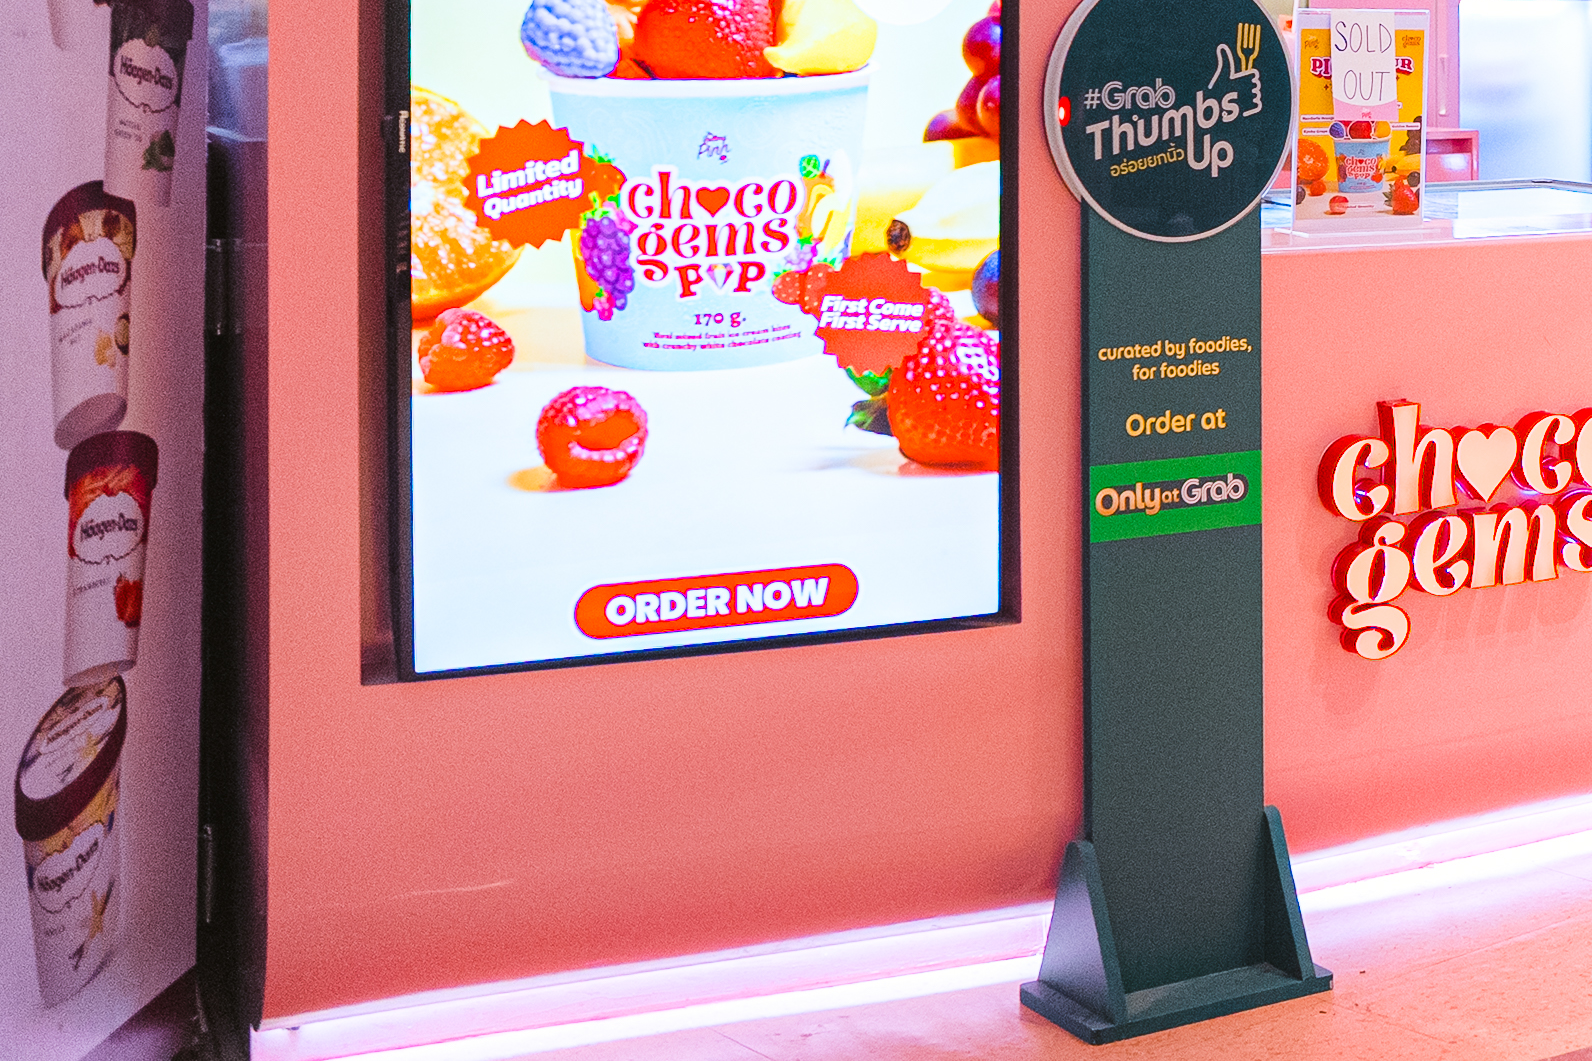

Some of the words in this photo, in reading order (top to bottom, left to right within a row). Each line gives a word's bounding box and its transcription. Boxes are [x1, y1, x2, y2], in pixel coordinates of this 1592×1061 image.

[1334, 20, 1393, 54] SOLD
[1084, 77, 1176, 111] #Grab
[1343, 69, 1391, 101] OUT
[1085, 90, 1240, 161] Thumbs
[1110, 143, 1185, 177] อร่อยยกนิ้ว
[1187, 133, 1234, 178] Up
[477, 149, 580, 198] Limited
[483, 178, 584, 220] Quantity
[637, 218, 790, 281] gems
[695, 313, 724, 326] 170
[819, 311, 867, 330] First
[866, 314, 923, 332] Serve
[820, 294, 868, 313] First
[868, 298, 925, 317] Come
[1098, 340, 1162, 361] curated
[1164, 340, 1186, 359] by
[1188, 336, 1252, 355] foodies,
[1132, 363, 1157, 381] for
[1160, 360, 1220, 379] foodies
[1125, 410, 1196, 437] Order
[1200, 408, 1227, 430] at
[1095, 482, 1161, 517] Only
[1161, 487, 1180, 504] at
[1180, 472, 1245, 506] Grab
[603, 583, 731, 625] ORDER
[735, 576, 831, 615] NOW
